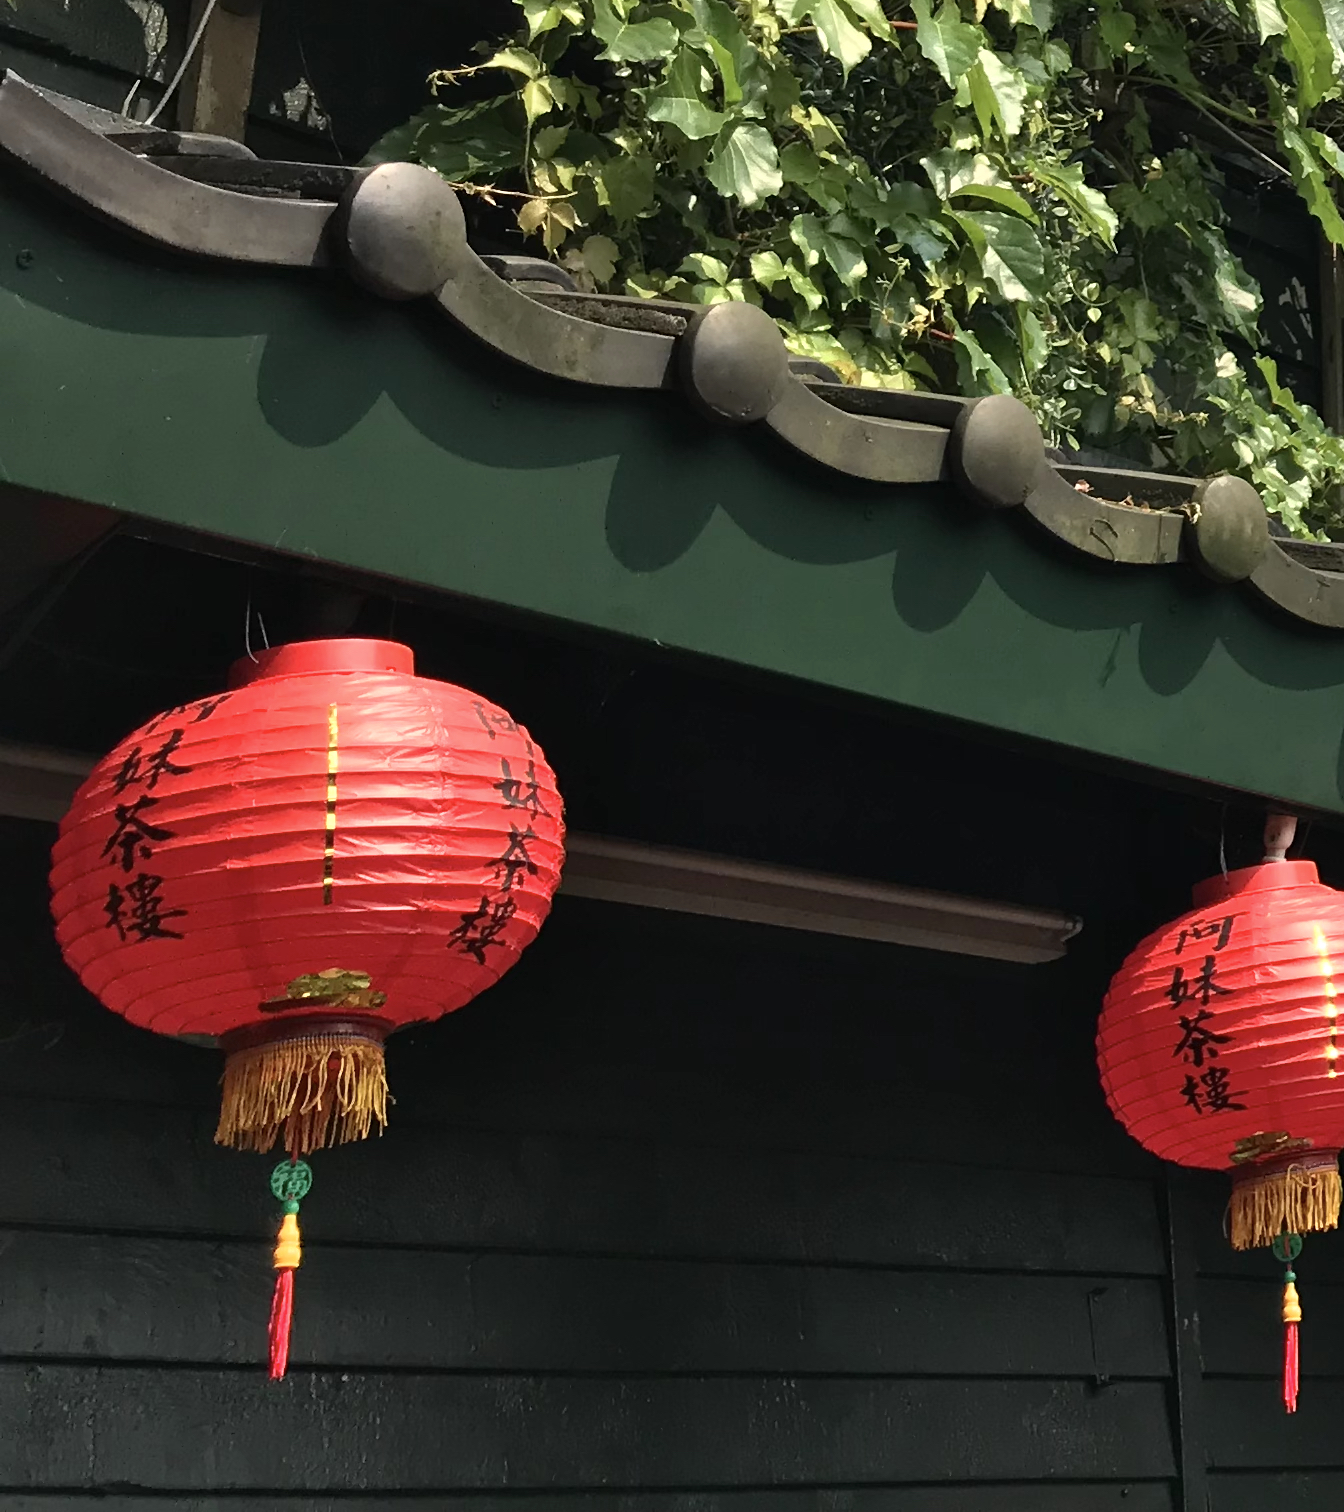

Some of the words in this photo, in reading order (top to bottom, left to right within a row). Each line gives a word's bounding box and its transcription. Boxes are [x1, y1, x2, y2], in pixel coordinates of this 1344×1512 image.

[101, 693, 233, 941] 阿妹茶樓
[447, 700, 554, 965] 阿妹茶樓
[1164, 911, 1250, 1115] 阿妹茶樓
